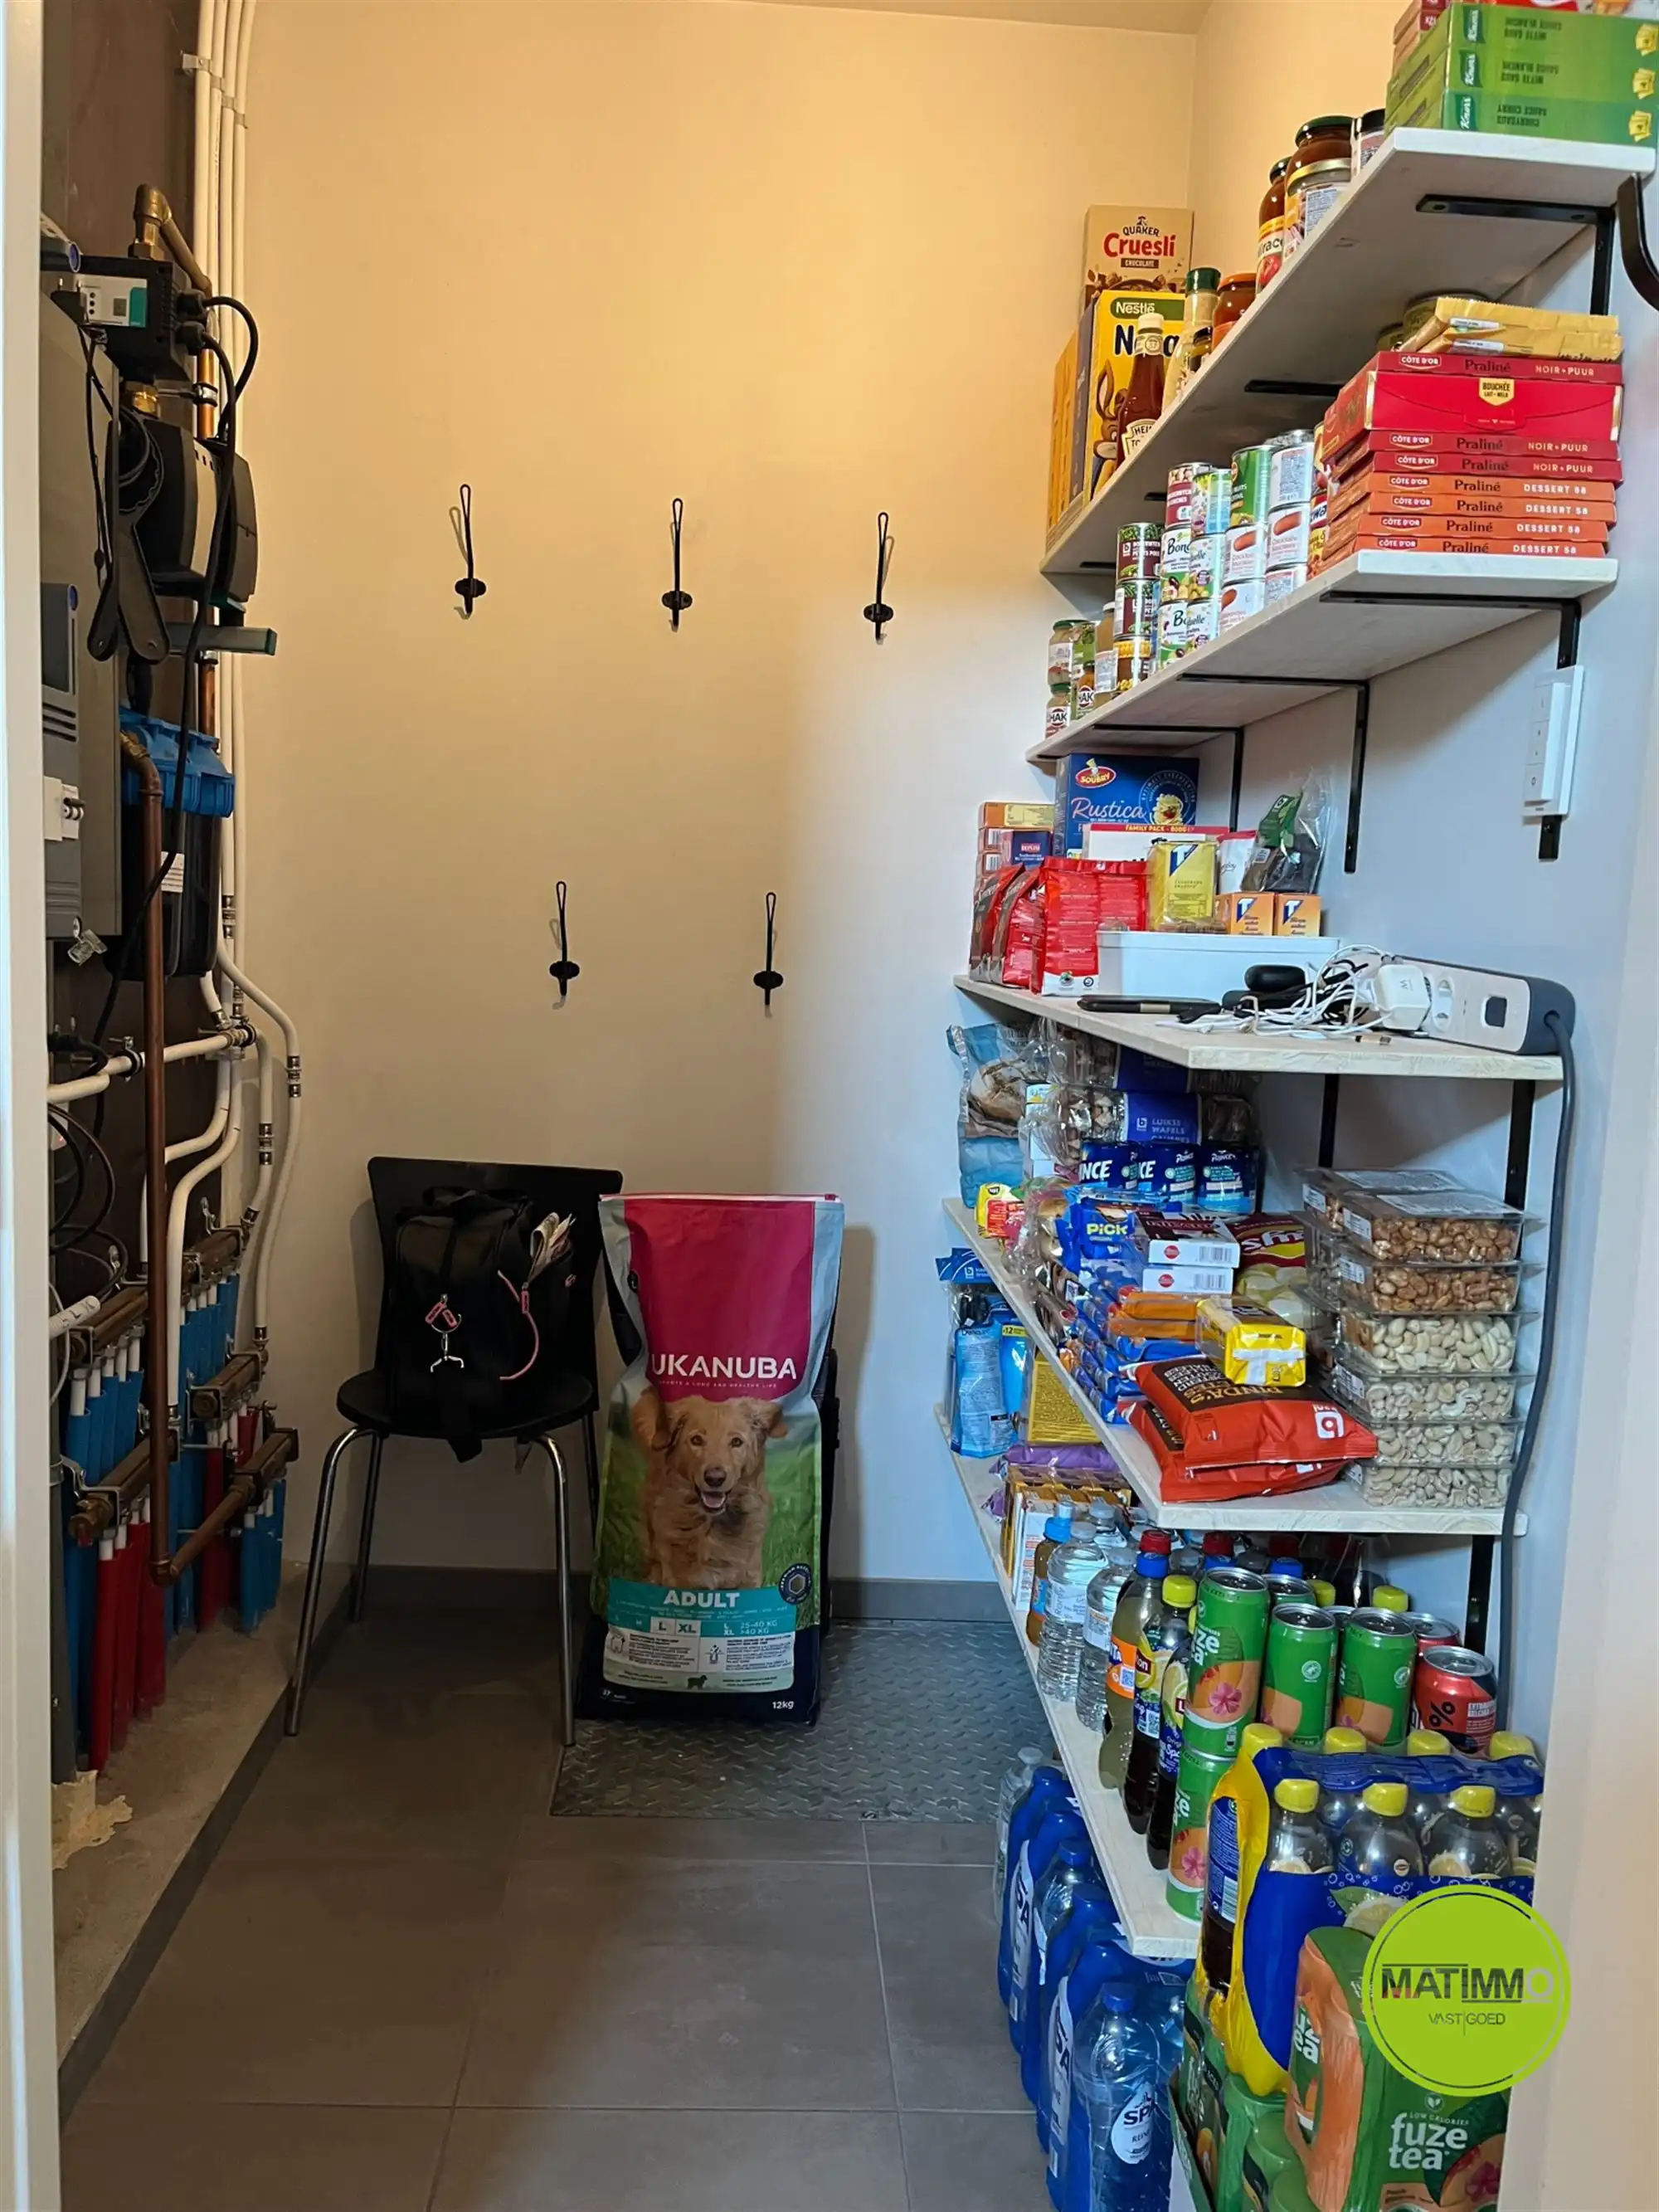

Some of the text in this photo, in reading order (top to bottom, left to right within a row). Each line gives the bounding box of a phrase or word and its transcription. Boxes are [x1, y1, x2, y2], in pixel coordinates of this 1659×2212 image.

[1122, 226, 1160, 236] QUAKER
[1465, 358, 1594, 376] Praliné NOIR PUUR
[1457, 437, 1588, 452] Praliné NOIR PUUR
[1462, 458, 1593, 474] Praliné NOIR PUUR
[1454, 480, 1501, 492] Praliné
[1524, 484, 1570, 494] DESSERT
[1457, 499, 1503, 513] Praliné
[1525, 504, 1572, 514] DESSERT
[1447, 519, 1493, 533] Praliné
[1516, 523, 1564, 534] DESSERT
[1443, 541, 1489, 553] Praliné
[1513, 543, 1560, 553] DESSERT
[1071, 797, 1146, 819] Rustica
[664, 1590, 740, 1609] ADULT
[659, 1621, 667, 1631] L
[679, 1624, 697, 1633] XL
[772, 1701, 795, 1709] 12kg
[1430, 2113, 1469, 2125] CALORIES
[1390, 2112, 1468, 2149] fuze
[1389, 2145, 1443, 2171] tea
